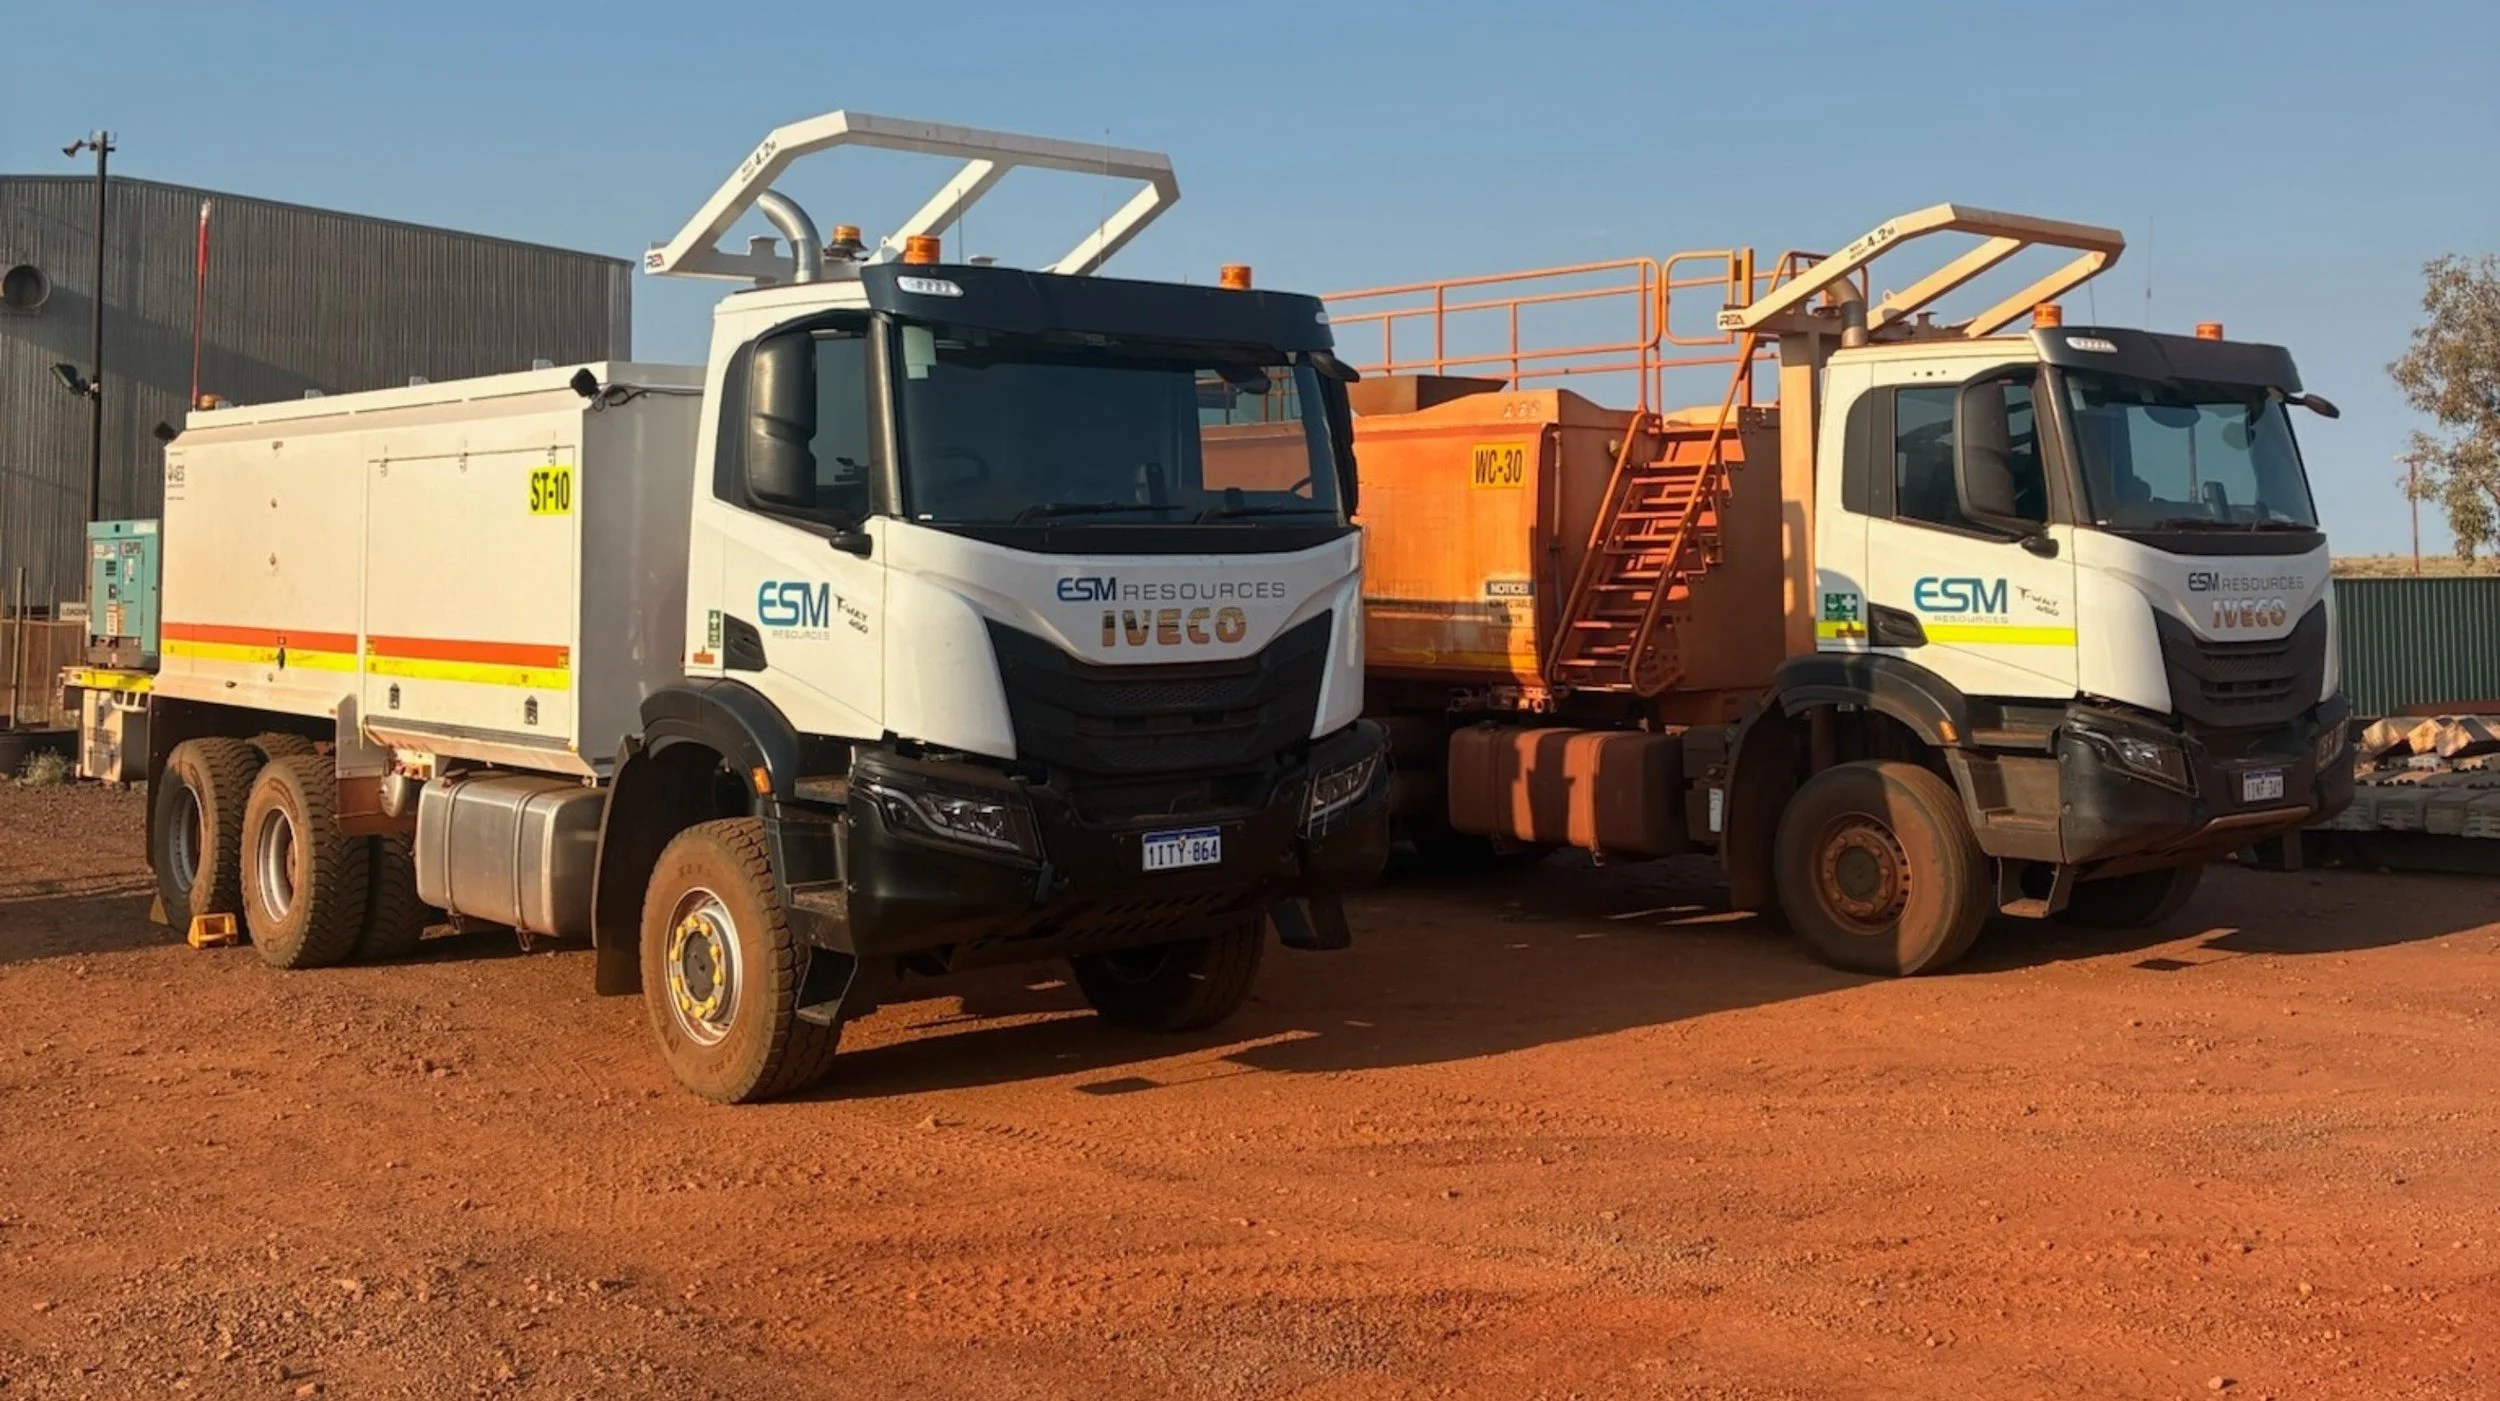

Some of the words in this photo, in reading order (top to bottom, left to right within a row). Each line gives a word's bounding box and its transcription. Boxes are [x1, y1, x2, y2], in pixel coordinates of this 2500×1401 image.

[1475, 449, 1523, 484] WC-30
[531, 471, 570, 512] ST-10
[1057, 577, 1117, 602] ESM
[1123, 581, 1286, 601] RESOURCES
[1914, 576, 2008, 614] ESM
[2188, 571, 2220, 592] ESM
[2222, 576, 2304, 592] RESOURCES
[758, 581, 830, 628] ESM
[2211, 597, 2287, 629] IVECO
[1102, 606, 1247, 647] IVECO
